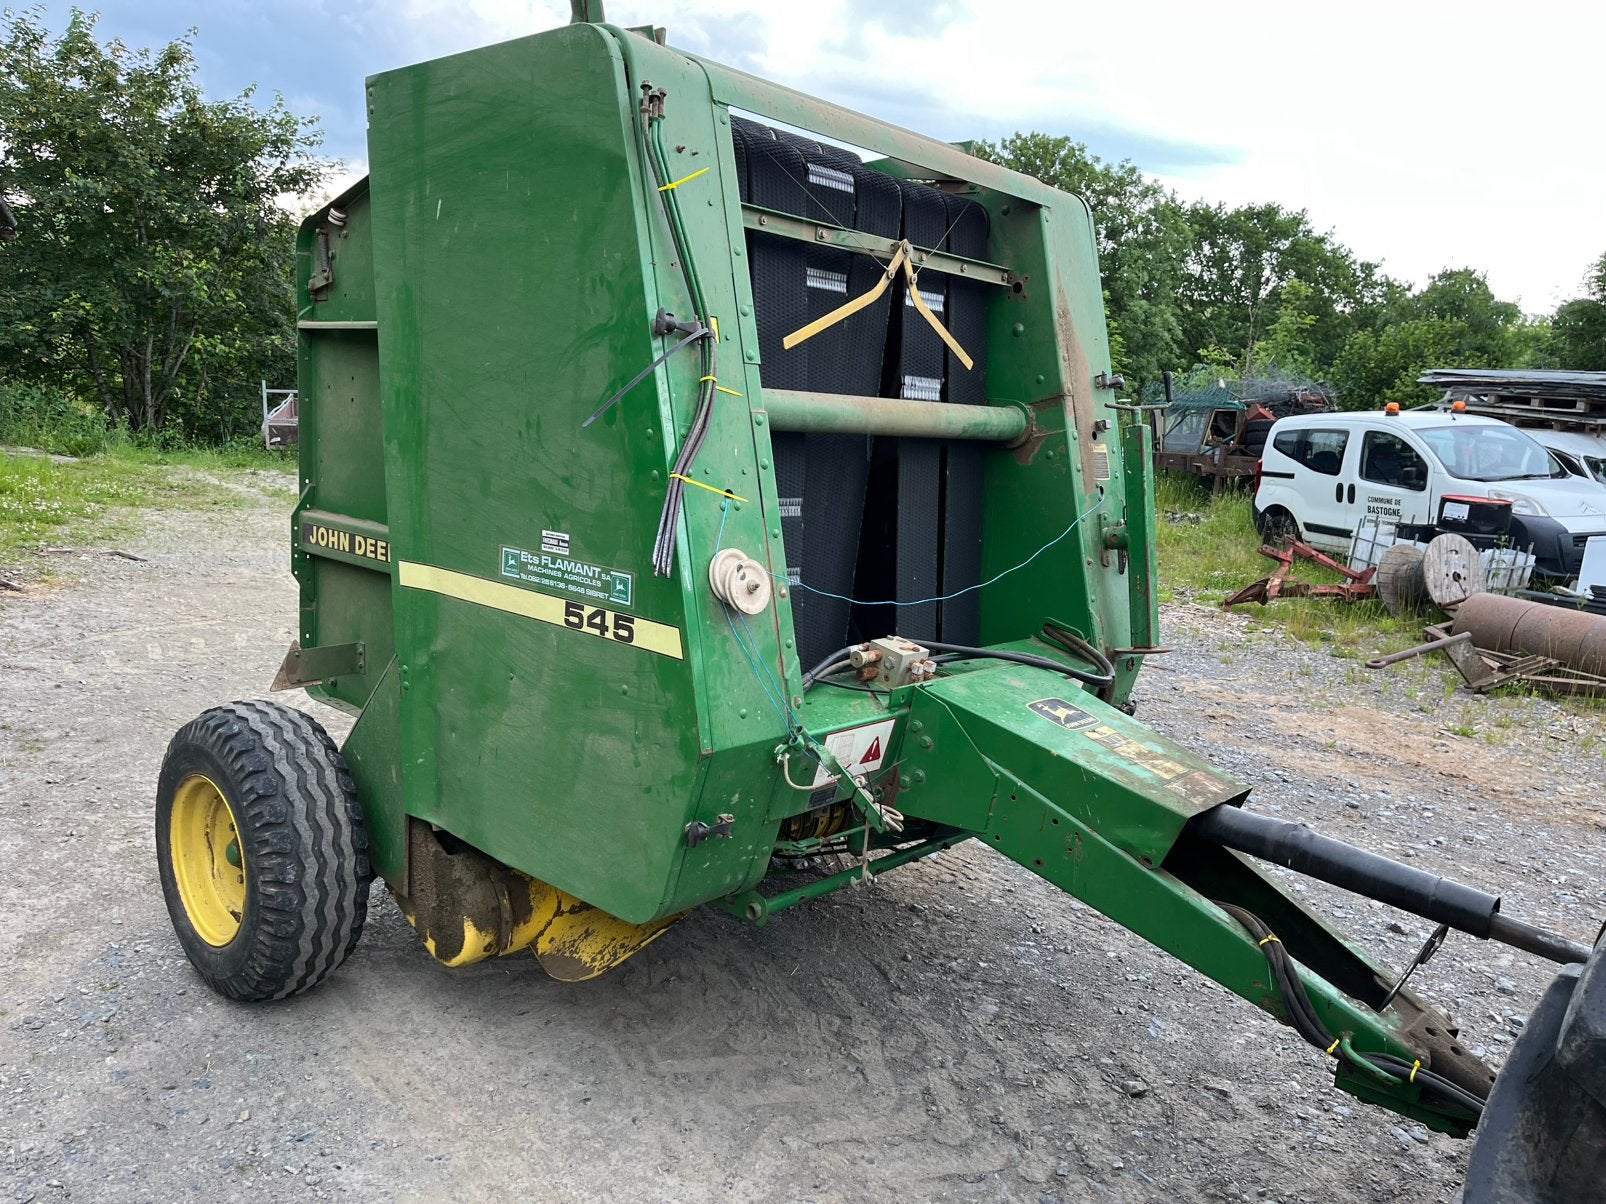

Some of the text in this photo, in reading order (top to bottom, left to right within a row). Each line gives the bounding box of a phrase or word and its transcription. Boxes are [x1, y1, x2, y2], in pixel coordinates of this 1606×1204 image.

[1367, 496, 1401, 506] COMMUNE DE
[1367, 505, 1401, 517] BASTOGNE
[309, 525, 391, 563] JOHN DEE
[520, 551, 611, 582] Ets FLAMANT SA
[527, 564, 562, 578] MACHINES
[563, 573, 602, 587] AGRICOLES
[586, 588, 609, 600] SIBRET
[564, 601, 635, 644] 545
